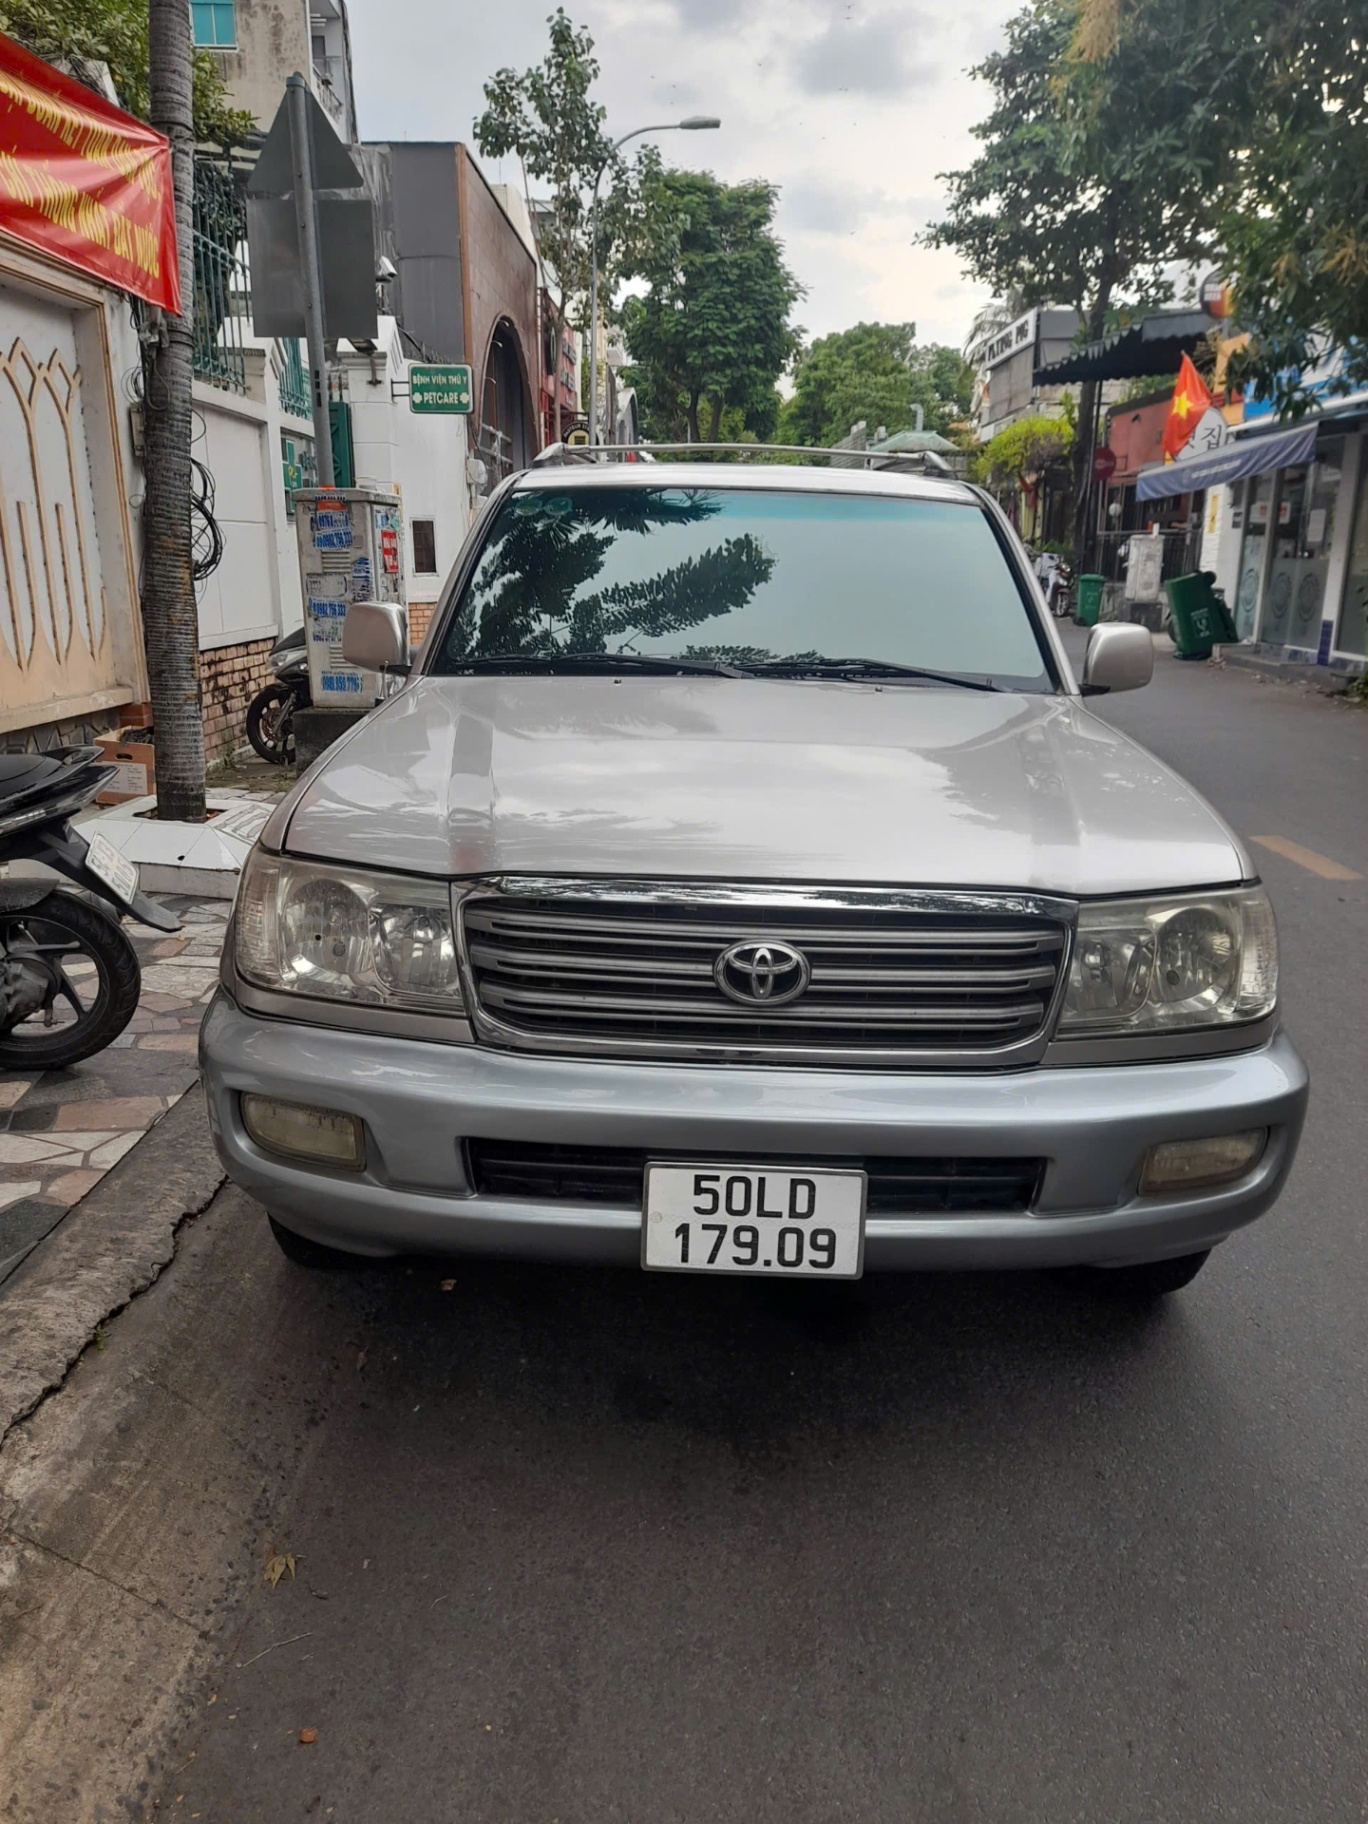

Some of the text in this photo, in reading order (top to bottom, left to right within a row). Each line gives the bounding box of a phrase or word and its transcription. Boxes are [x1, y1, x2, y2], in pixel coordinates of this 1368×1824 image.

[23, 160, 78, 233] THỐNG
[78, 187, 110, 250] NHẤT
[111, 200, 133, 263] ĐẤT
[134, 222, 159, 279] NƯỚC
[1015, 319, 1029, 344] PIG
[412, 373, 430, 387] BỆNH
[432, 373, 447, 386] VIỆN
[463, 375, 468, 384] Y
[423, 391, 459, 404] PETCARE
[693, 1174, 817, 1220] 50LD
[675, 1222, 837, 1269] 179.09
